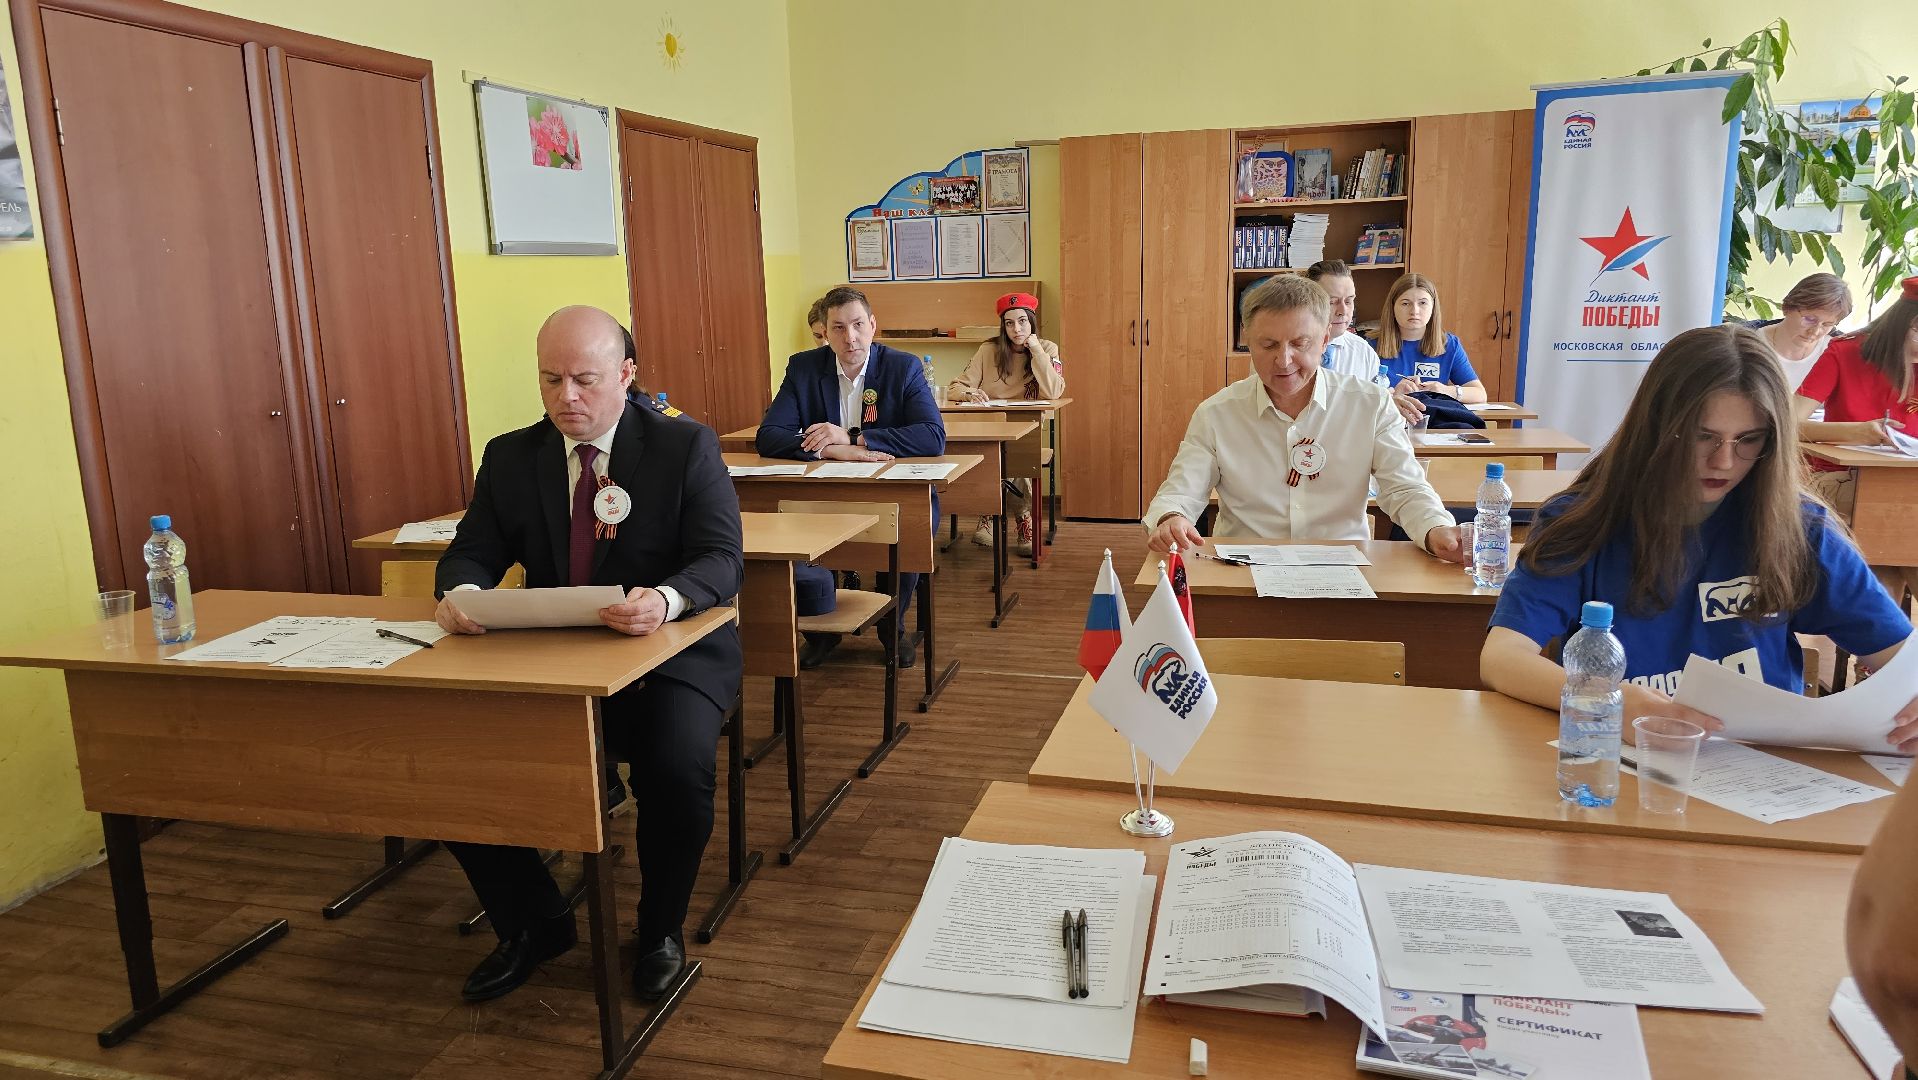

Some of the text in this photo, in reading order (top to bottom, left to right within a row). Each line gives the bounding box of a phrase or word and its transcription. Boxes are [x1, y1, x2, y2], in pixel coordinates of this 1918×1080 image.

[1563, 142, 1592, 150] РОССИЯ
[0, 202, 22, 213] ЕЛЬ
[1584, 289, 1661, 303] Диктант
[1582, 305, 1661, 329] ПОБЕДЫ
[1553, 342, 1624, 351] МОСКОВСКАЯ
[1169, 670, 1201, 713] ЕДИНАЯ
[1178, 676, 1208, 720] РОССИЯ
[1497, 1016, 1603, 1040] СЕРТИФИКАТ
